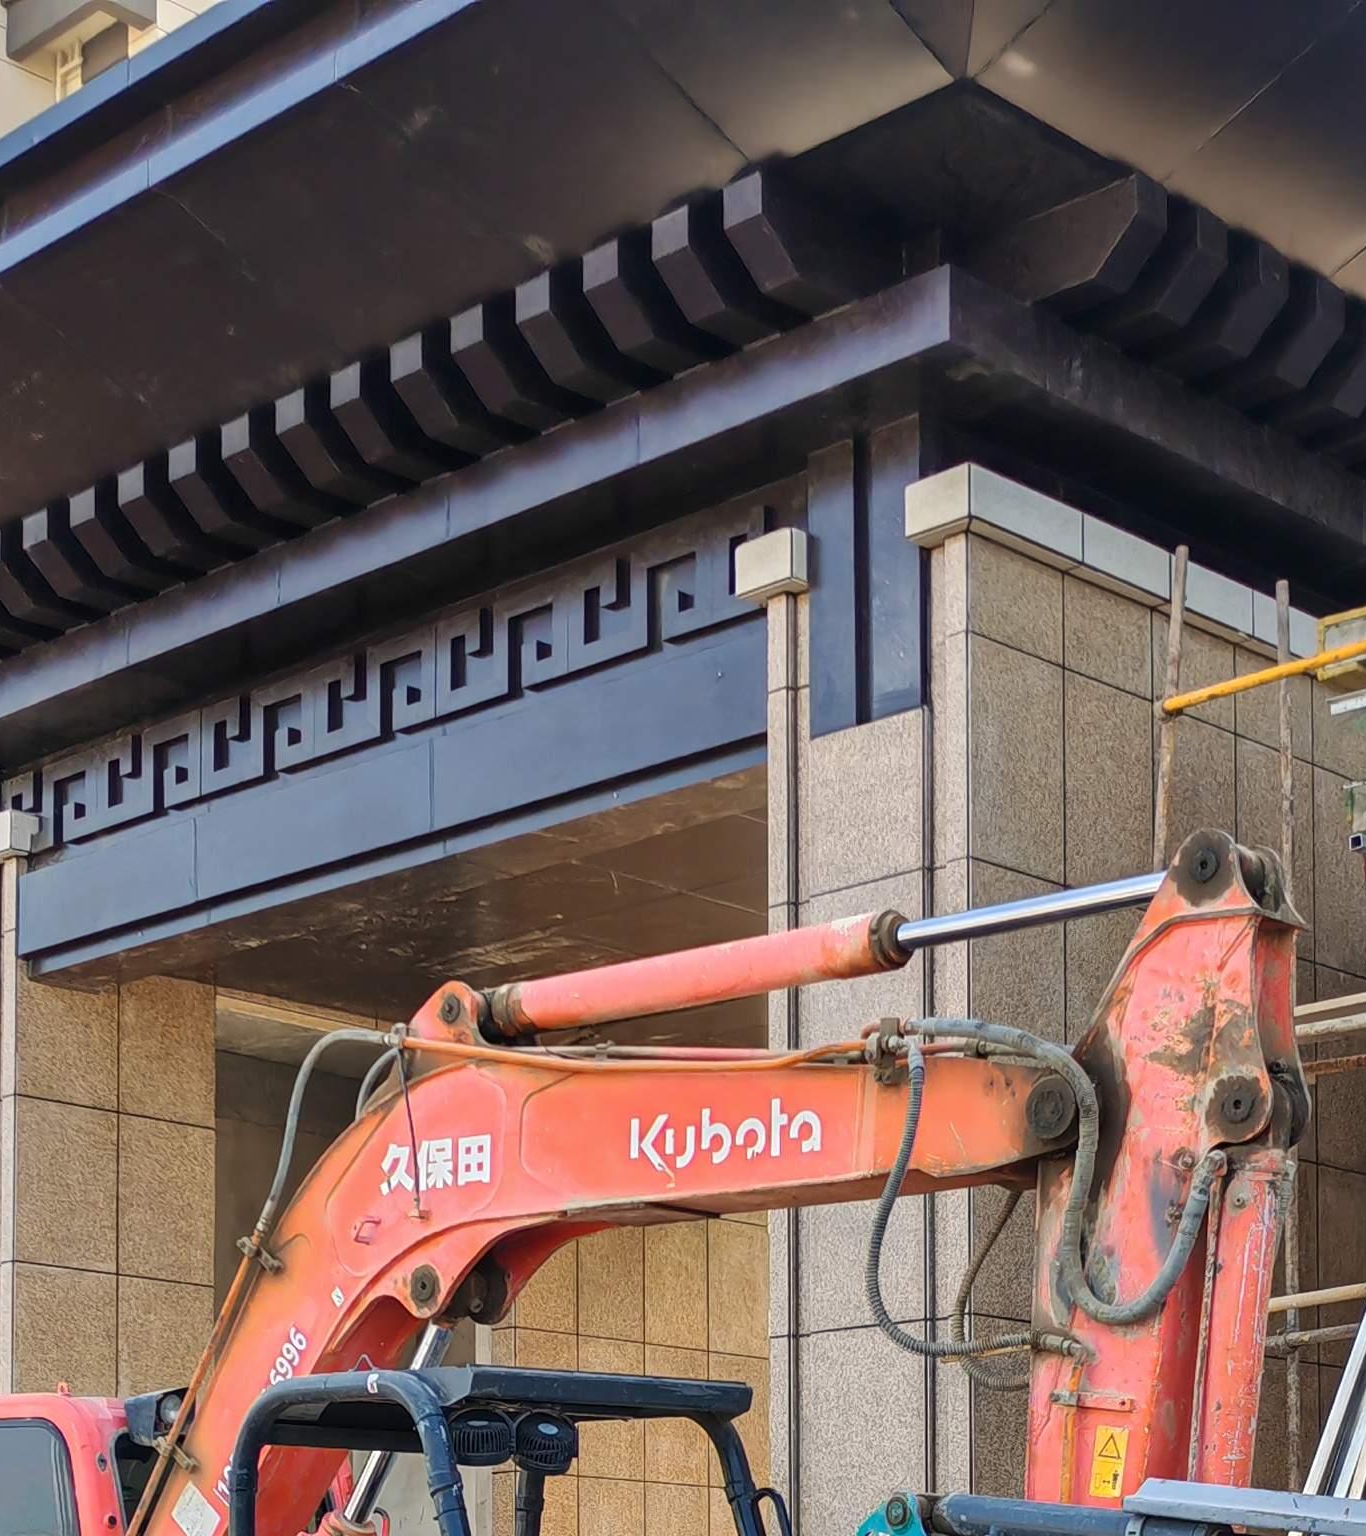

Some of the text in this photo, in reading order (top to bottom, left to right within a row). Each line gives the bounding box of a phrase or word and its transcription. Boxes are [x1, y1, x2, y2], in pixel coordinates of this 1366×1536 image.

[379, 1133, 492, 1197] 久保田
[629, 1096, 823, 1186] Kubota
